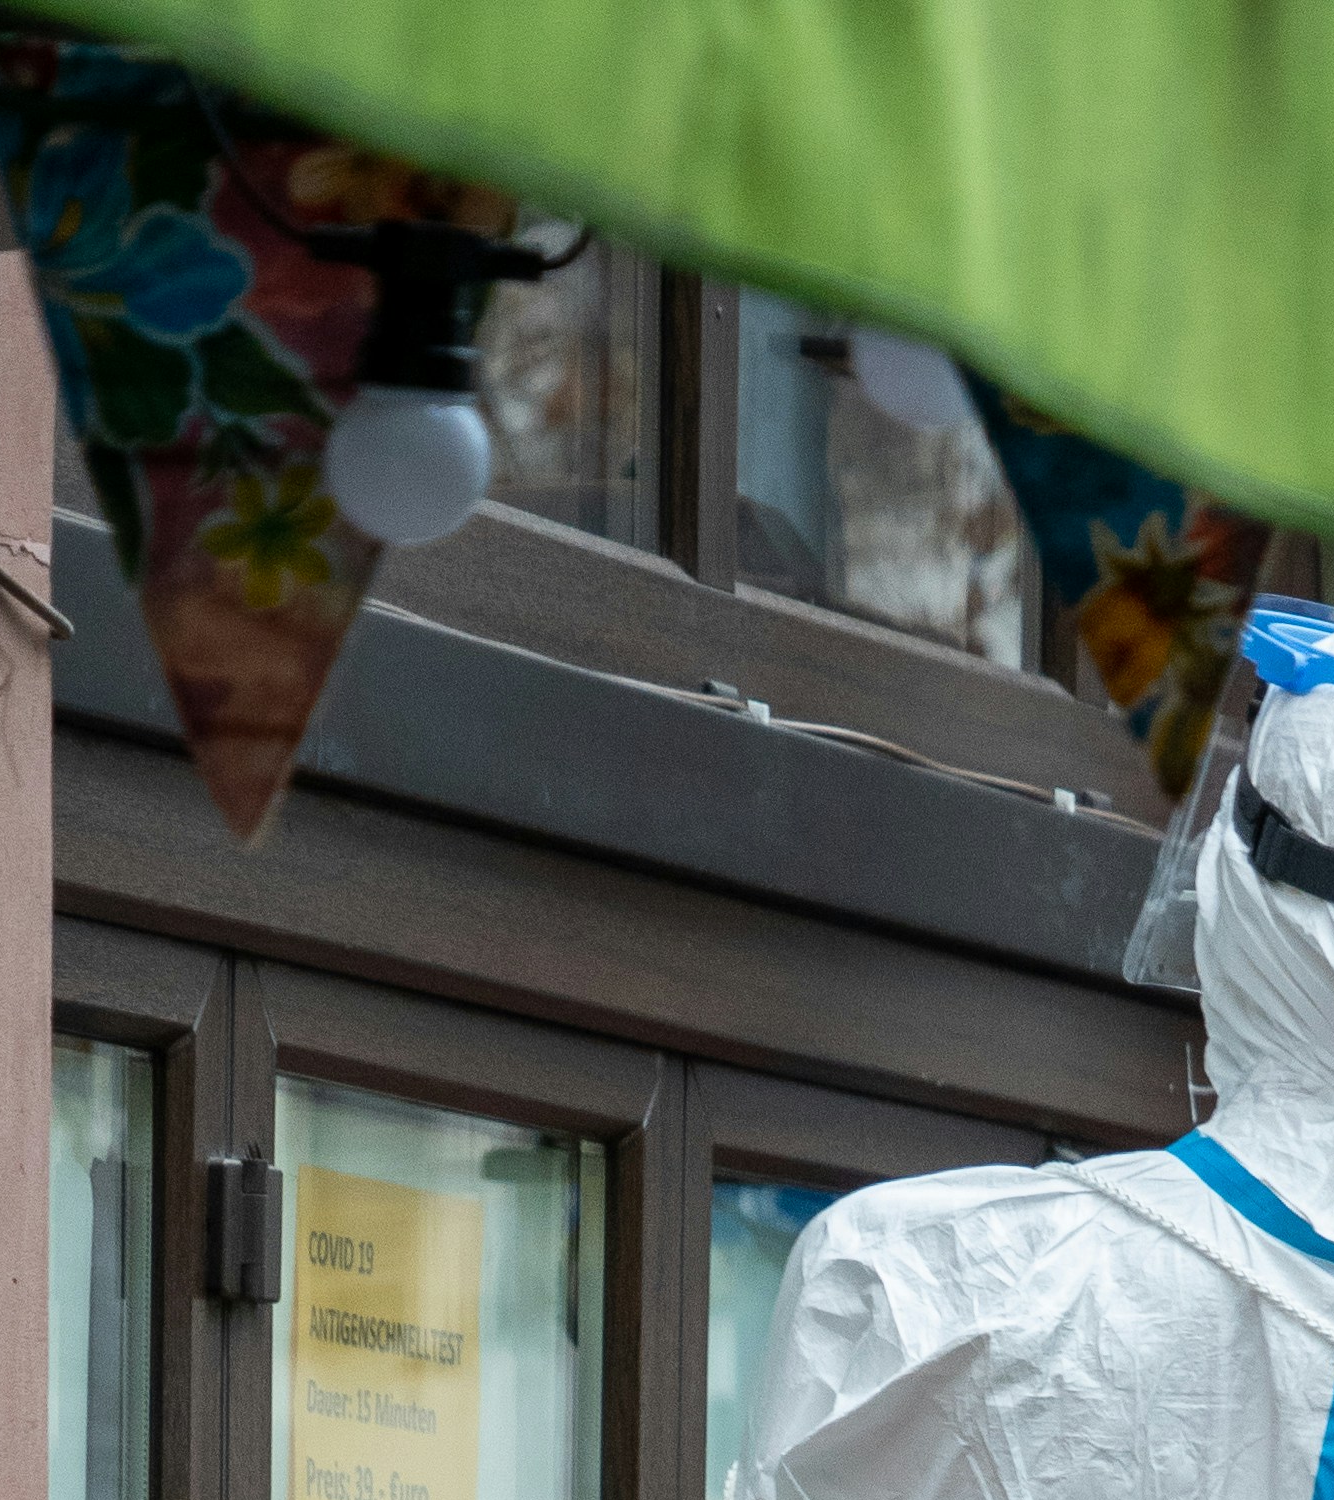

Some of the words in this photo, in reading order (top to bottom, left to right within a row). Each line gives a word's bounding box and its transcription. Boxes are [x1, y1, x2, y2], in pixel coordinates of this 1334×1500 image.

[308, 1230, 355, 1272] COVID
[357, 1240, 376, 1275] 19
[309, 1305, 464, 1366] ANTIGENSCHNELLTEST
[307, 1379, 353, 1420] Dauer:
[356, 1389, 371, 1423] 15
[375, 1392, 437, 1434] Minuten
